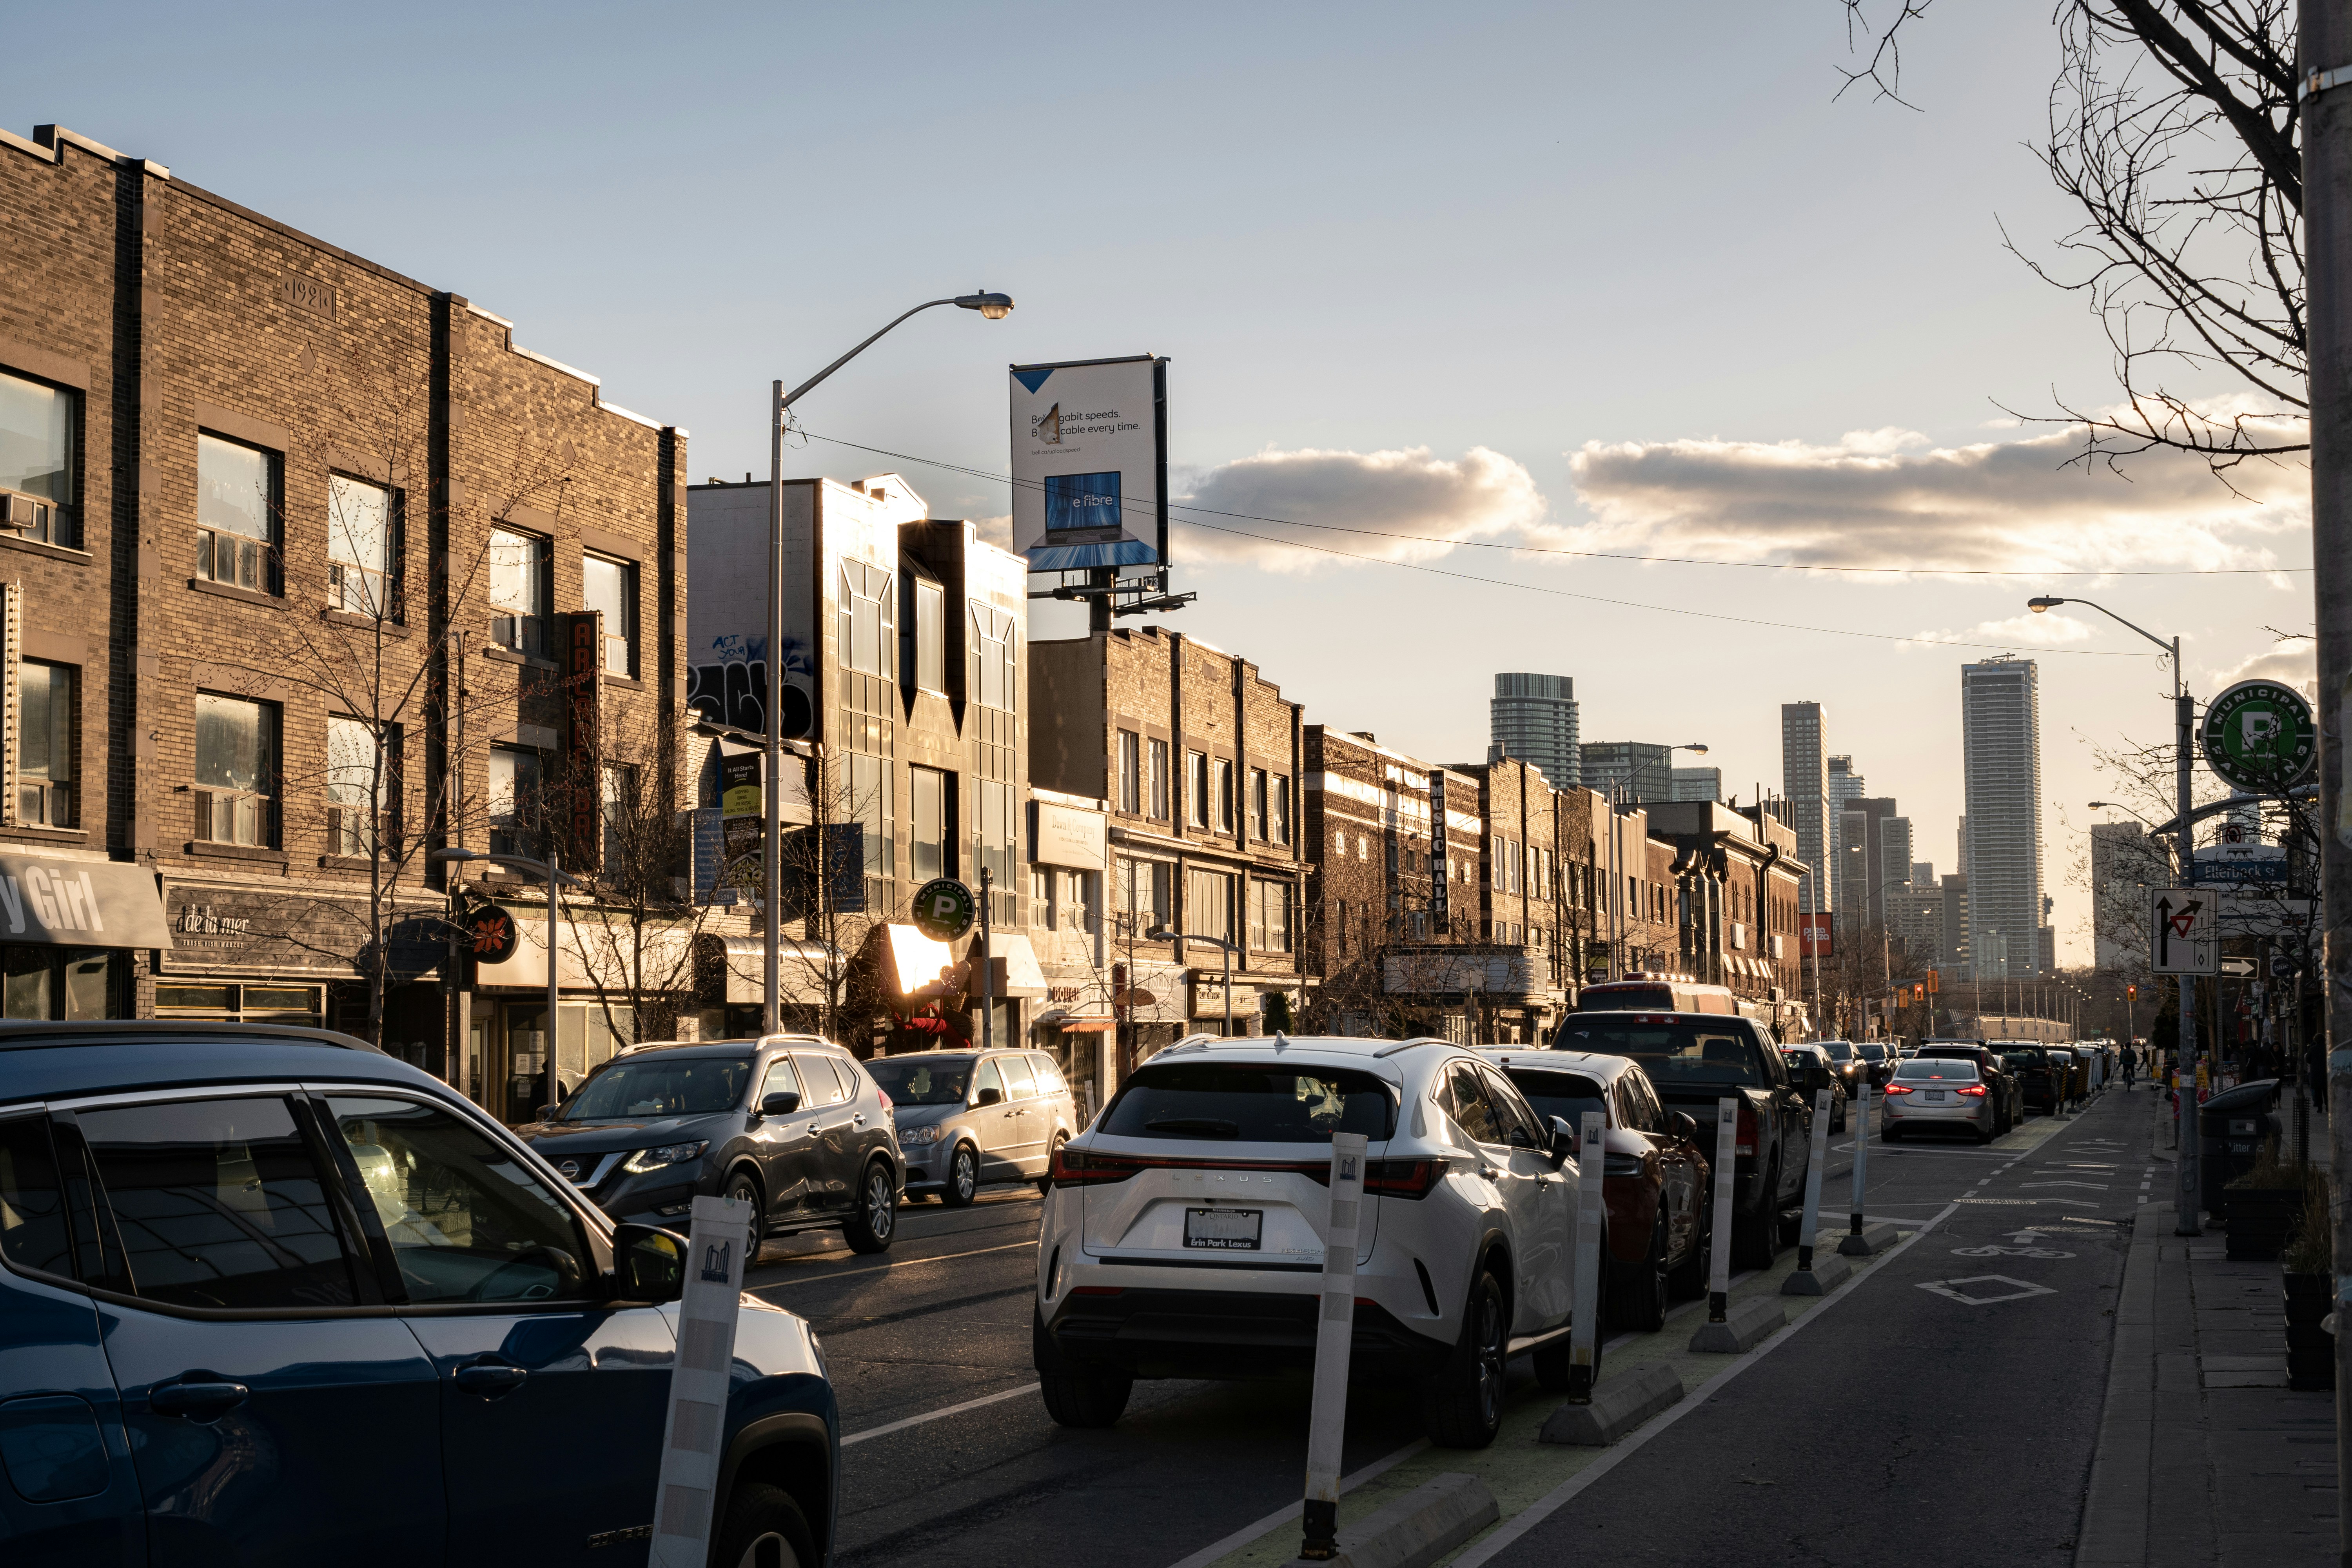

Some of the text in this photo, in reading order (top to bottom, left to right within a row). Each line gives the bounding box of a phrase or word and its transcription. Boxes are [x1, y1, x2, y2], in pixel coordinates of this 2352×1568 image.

[1058, 411, 1083, 425] gabit
[1085, 409, 1121, 421] speeds.
[1060, 421, 1141, 435] cable every time.
[1032, 447, 1080, 456] bell.ca/uploadspeed
[1084, 495, 1113, 506] fibre
[1144, 577, 1159, 586] 173
[712, 635, 739, 649] ACT
[718, 646, 745, 659] YOUR
[575, 622, 590, 771] ARCADE
[2213, 689, 2306, 725] MUNICIPAL
[2241, 711, 2282, 751] P
[1431, 785, 1444, 851] MUSIC
[1052, 815, 1094, 840] Down & Company
[2266, 867, 2275, 877] St
[1433, 858, 1446, 912] HALL
[25, 866, 103, 931] Girl
[920, 883, 970, 908] MUNICIPAL
[932, 895, 957, 918] P
[185, 904, 201, 933] de
[222, 917, 249, 935] mer
[916, 911, 968, 937] PARKING
[1804, 927, 1825, 936] piza
[1807, 934, 1829, 942] pzza
[1053, 986, 1079, 1002] DOUGH
[1172, 1174, 1272, 1183] LEXUS
[701, 1270, 728, 1284] TORONTO
[586, 1524, 654, 1549] COMPAS
